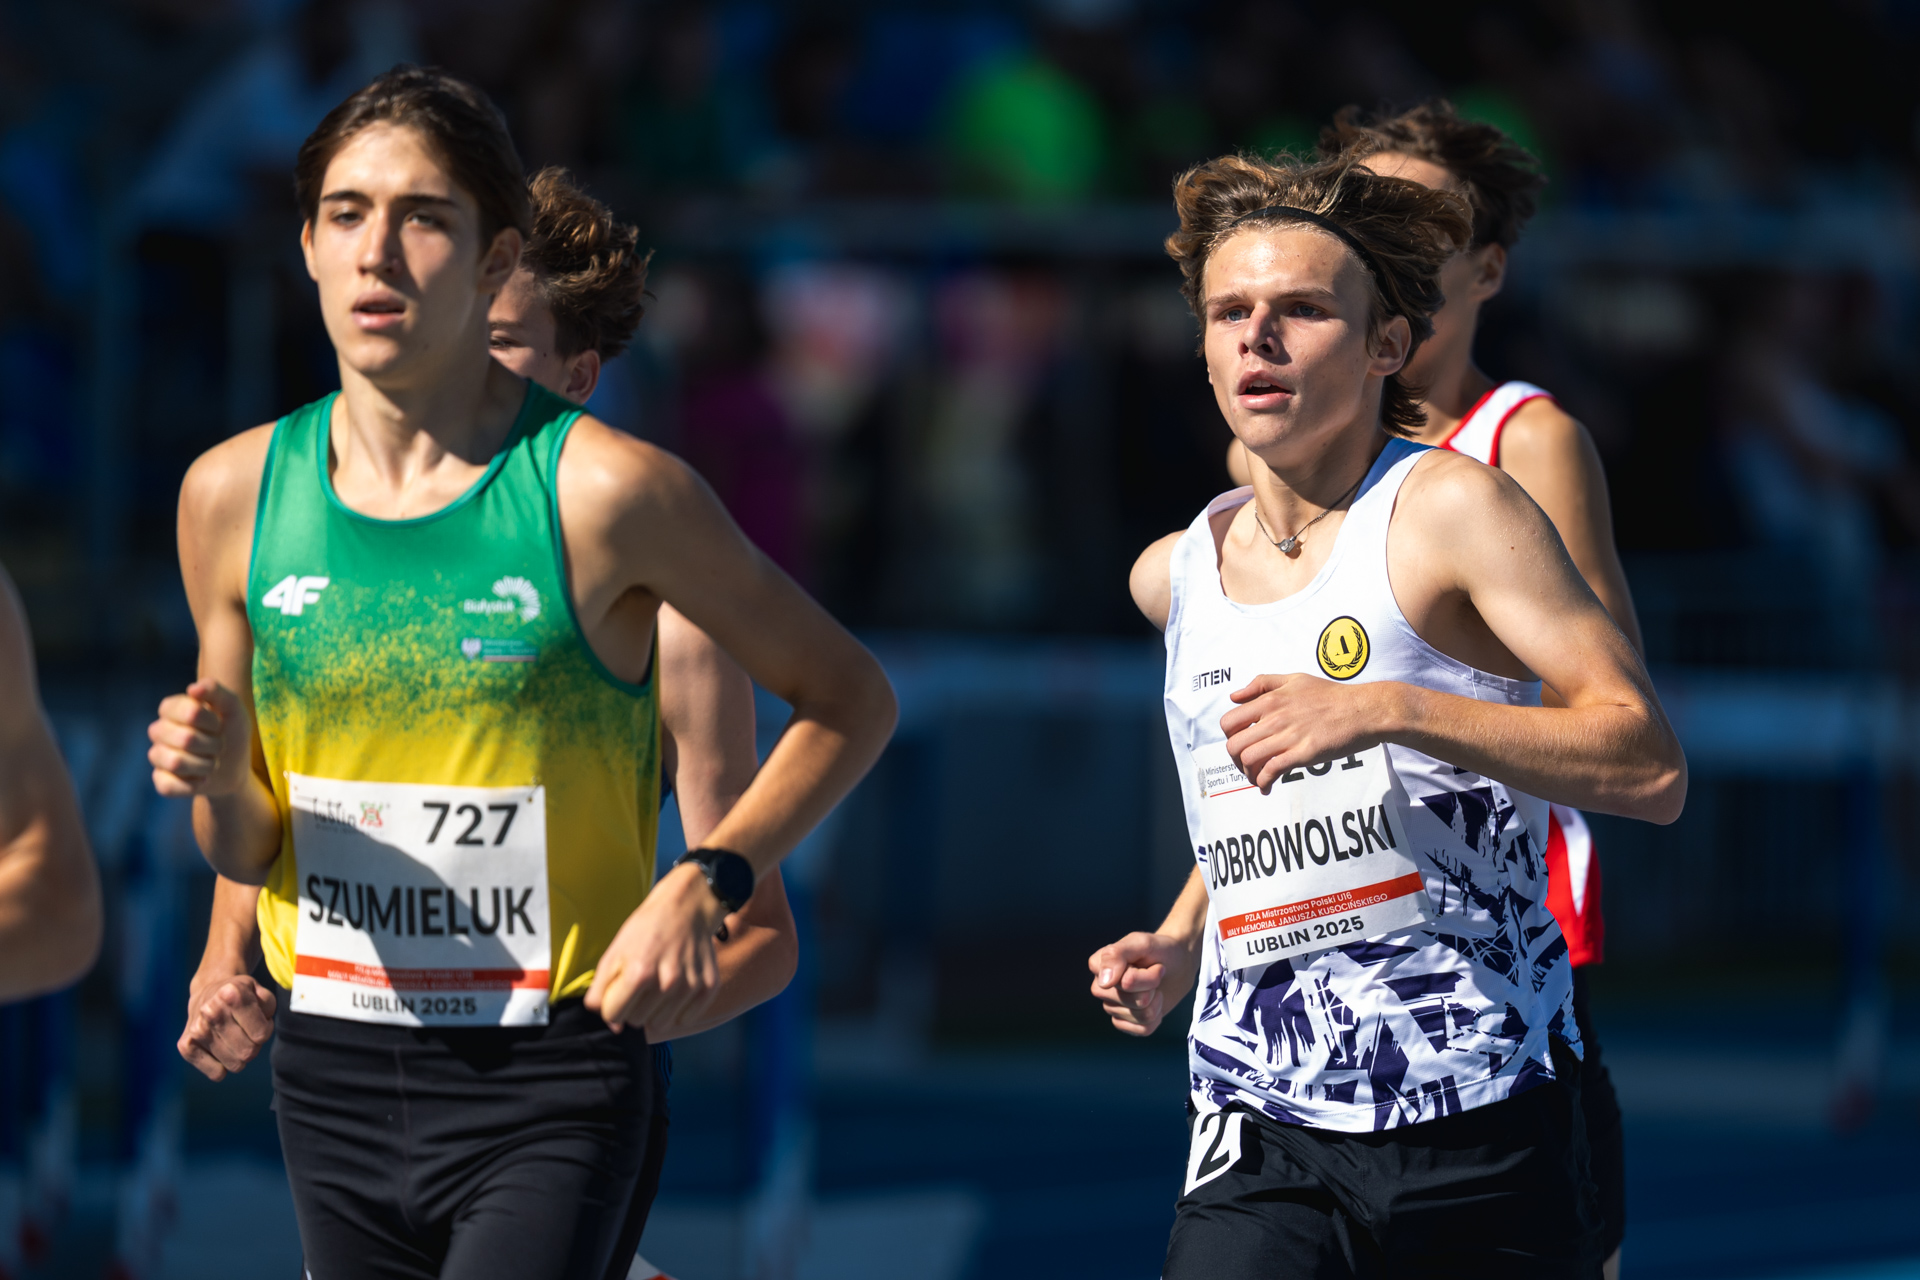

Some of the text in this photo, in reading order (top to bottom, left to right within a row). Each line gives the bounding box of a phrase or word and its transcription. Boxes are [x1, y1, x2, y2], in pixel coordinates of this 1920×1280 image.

[262, 574, 330, 616] 4F
[1207, 778, 1225, 788] Sportu
[423, 802, 518, 845] 727
[1208, 804, 1397, 890] DOBROWOLSKI
[307, 874, 536, 936] SZUMIELUK
[1227, 893, 1388, 937] MAŁY MEMORIAŁ JANUSZA KUSOCIŃSKIEGO
[1245, 892, 1352, 922] PZLA Mistrzostwa Polski U16
[1247, 915, 1364, 955] LUBLIN 2025
[352, 992, 477, 1016] LUBLIN 2025
[1195, 1112, 1230, 1181] 2
